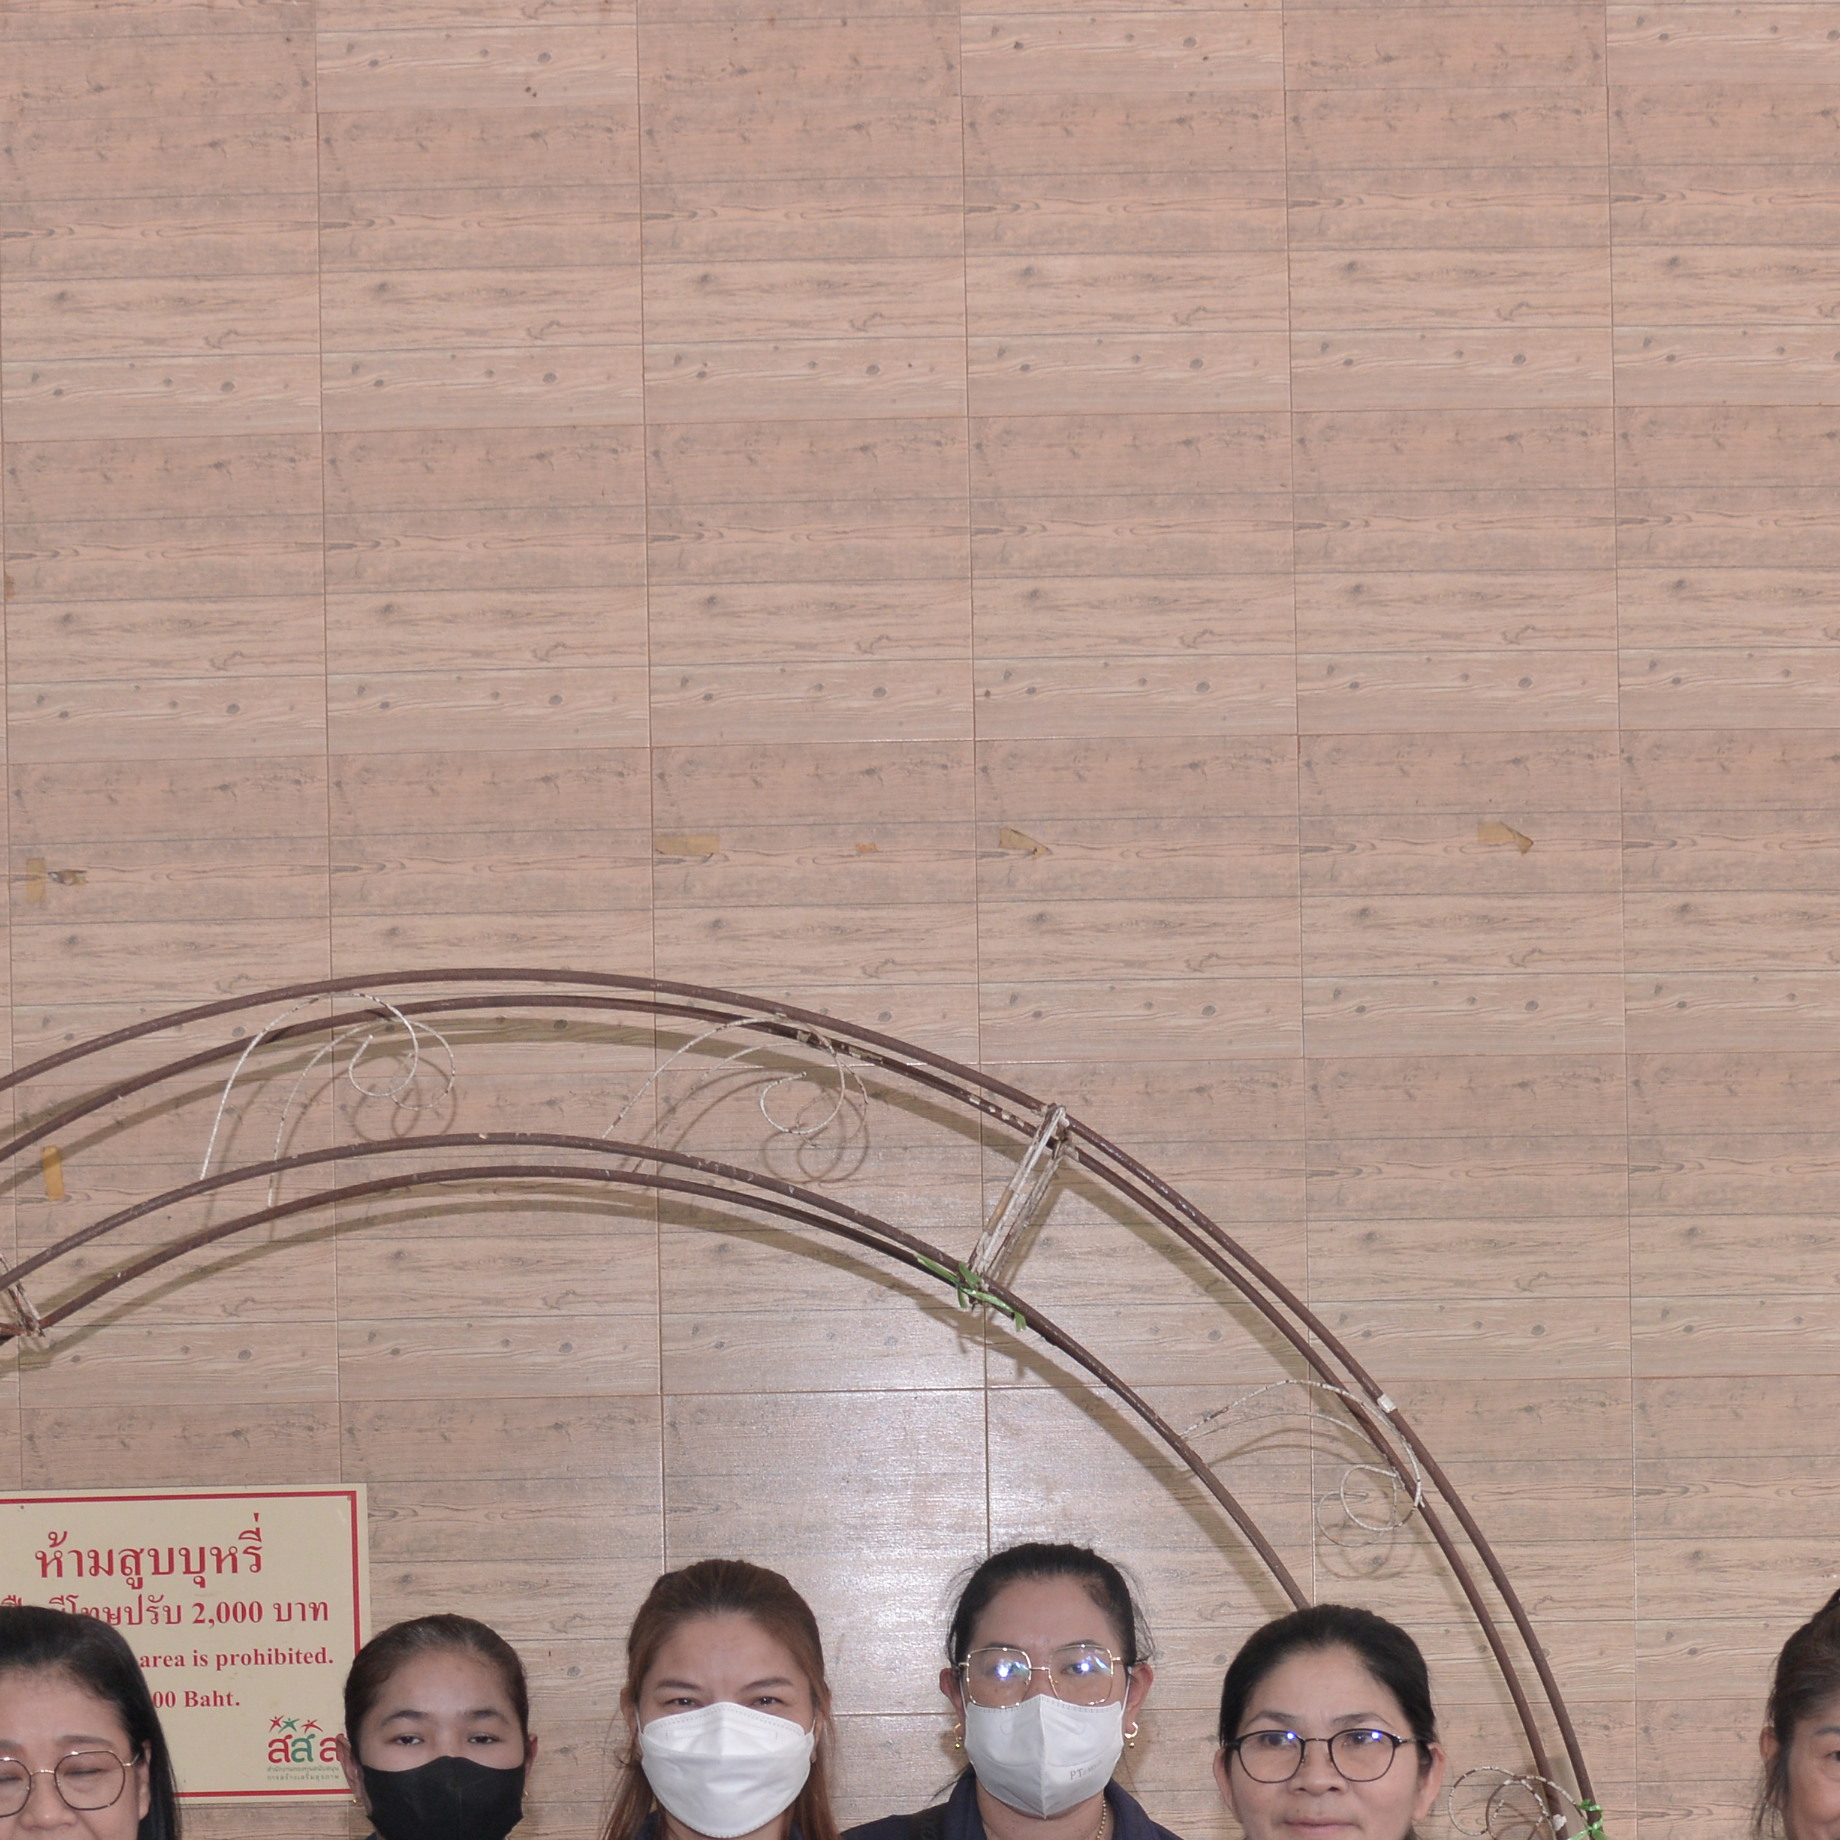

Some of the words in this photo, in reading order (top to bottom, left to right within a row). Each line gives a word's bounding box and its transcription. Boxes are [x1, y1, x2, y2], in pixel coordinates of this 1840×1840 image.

[35, 1512, 263, 1590] ห้ามสูบบุหรี่
[192, 1600, 264, 1629] 2,000
[273, 1600, 329, 1623] บาท
[139, 1653, 185, 1669] area
[193, 1650, 208, 1668] is
[215, 1646, 334, 1672] prohibited.
[184, 1689, 241, 1708] Baht.
